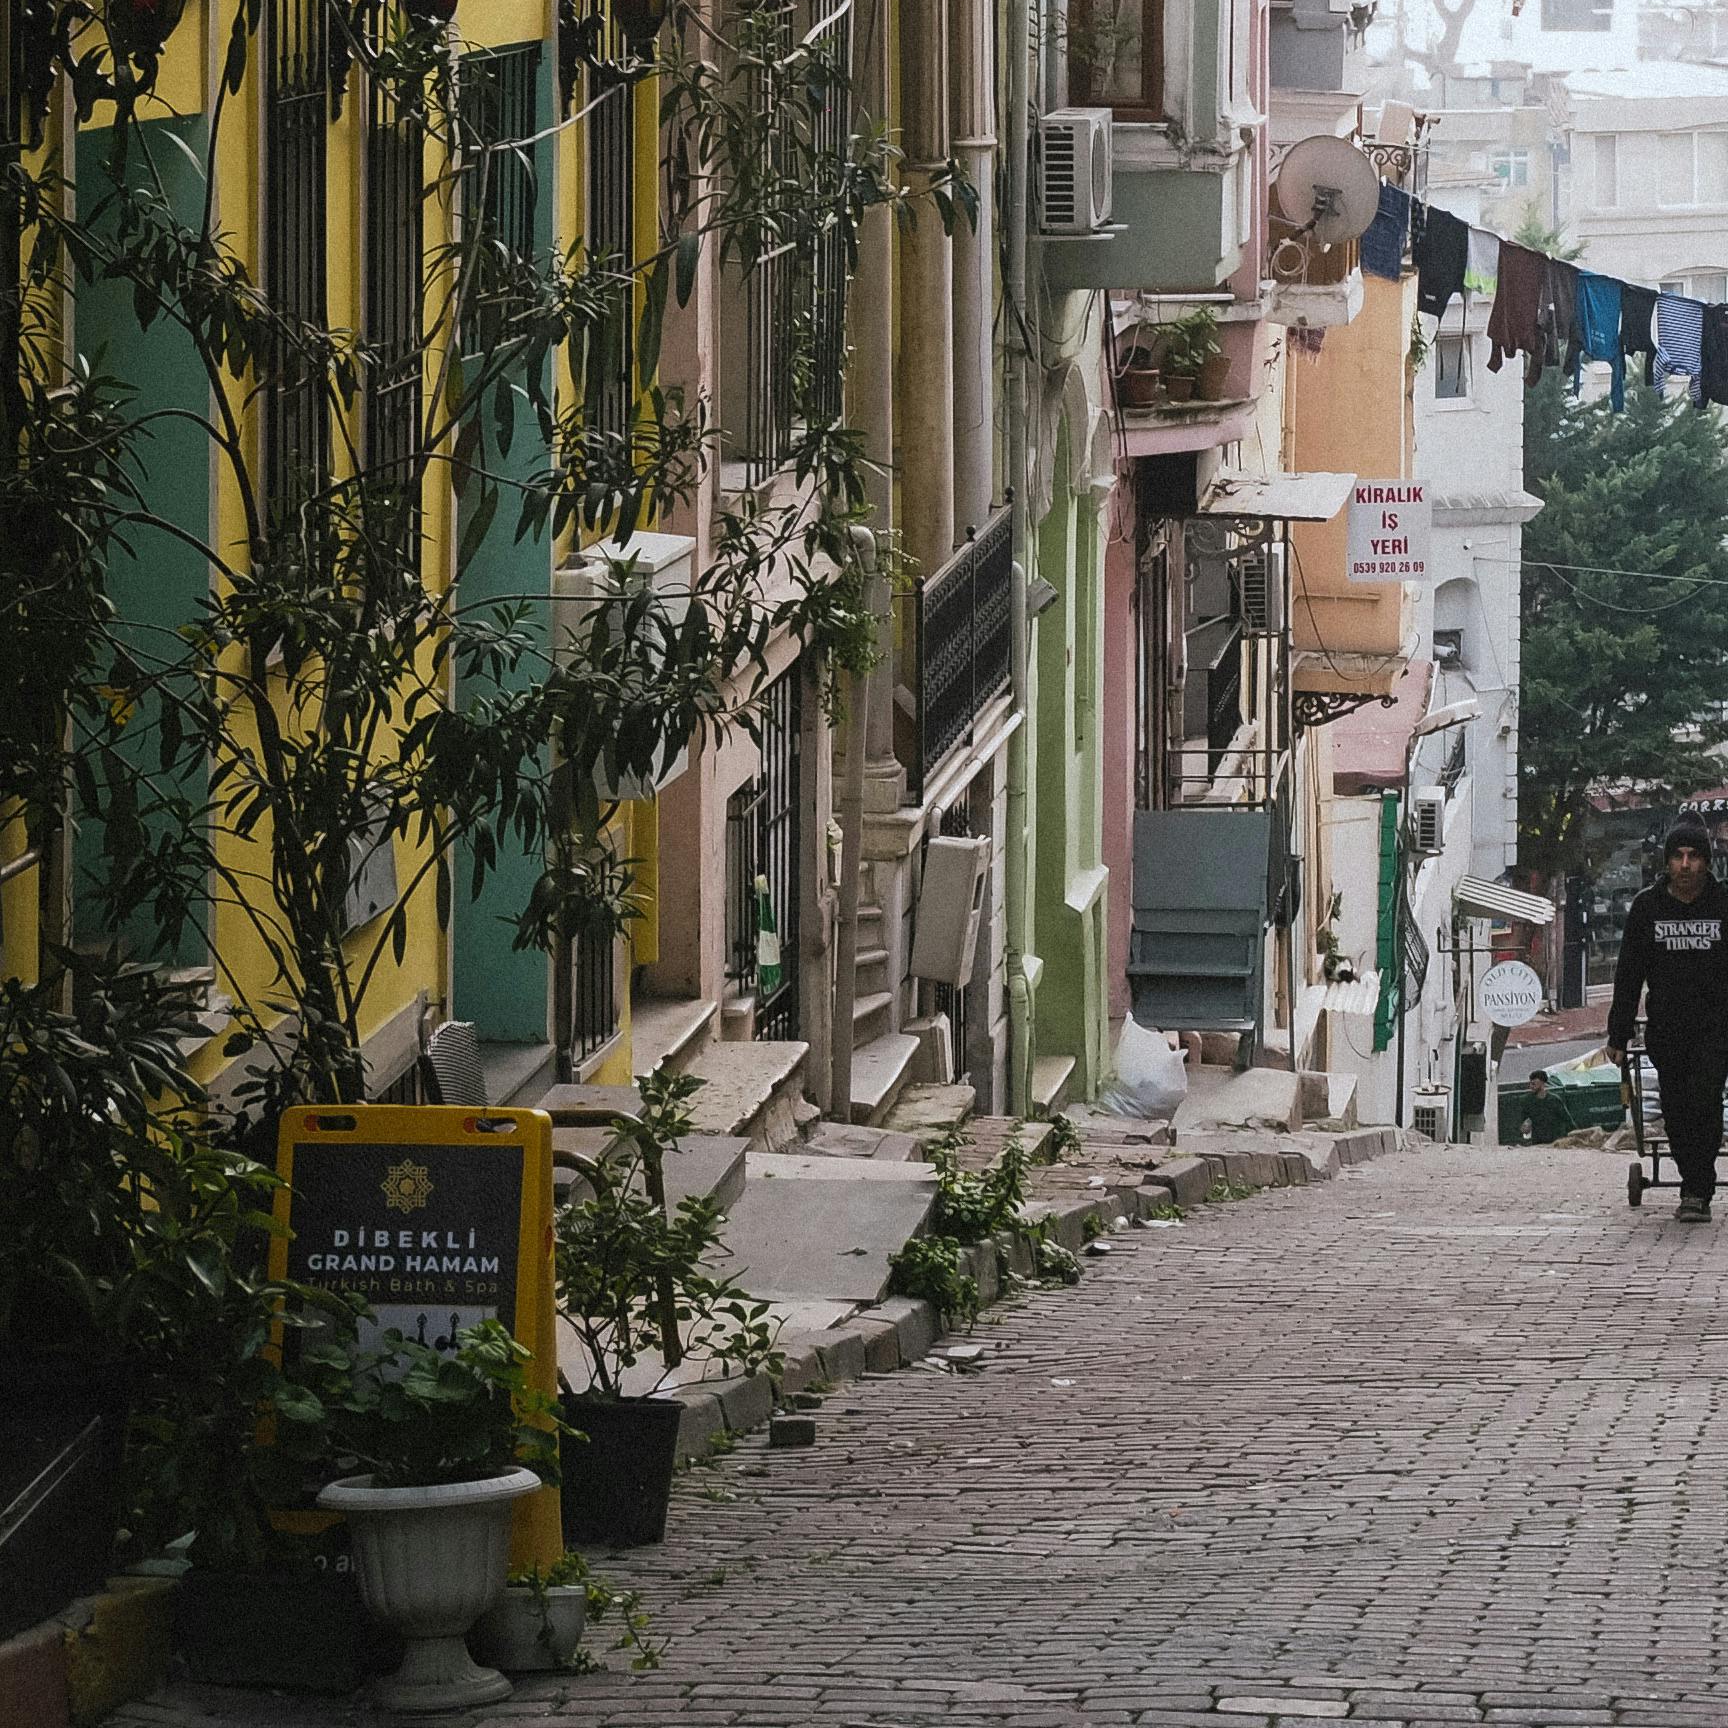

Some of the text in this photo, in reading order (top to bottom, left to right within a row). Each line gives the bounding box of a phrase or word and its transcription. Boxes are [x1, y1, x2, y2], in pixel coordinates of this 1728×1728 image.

[1355, 484, 1424, 504] KİRALIK
[1381, 510, 1399, 532] İŞ
[1370, 535, 1409, 555] YERİ
[1353, 562, 1376, 574] 0539
[1379, 561, 1396, 574] 920
[1399, 561, 1410, 573] 26
[1654, 920, 1722, 941] STRANGER
[1665, 936, 1712, 951] THINGS
[1484, 990, 1536, 1007] PANSİYON
[333, 1225, 477, 1249] DİBEKLİ
[307, 1253, 499, 1274] GRAND HAMAM
[389, 1277, 436, 1293] Bath
[444, 1279, 457, 1293] &
[465, 1279, 498, 1296] Spa
